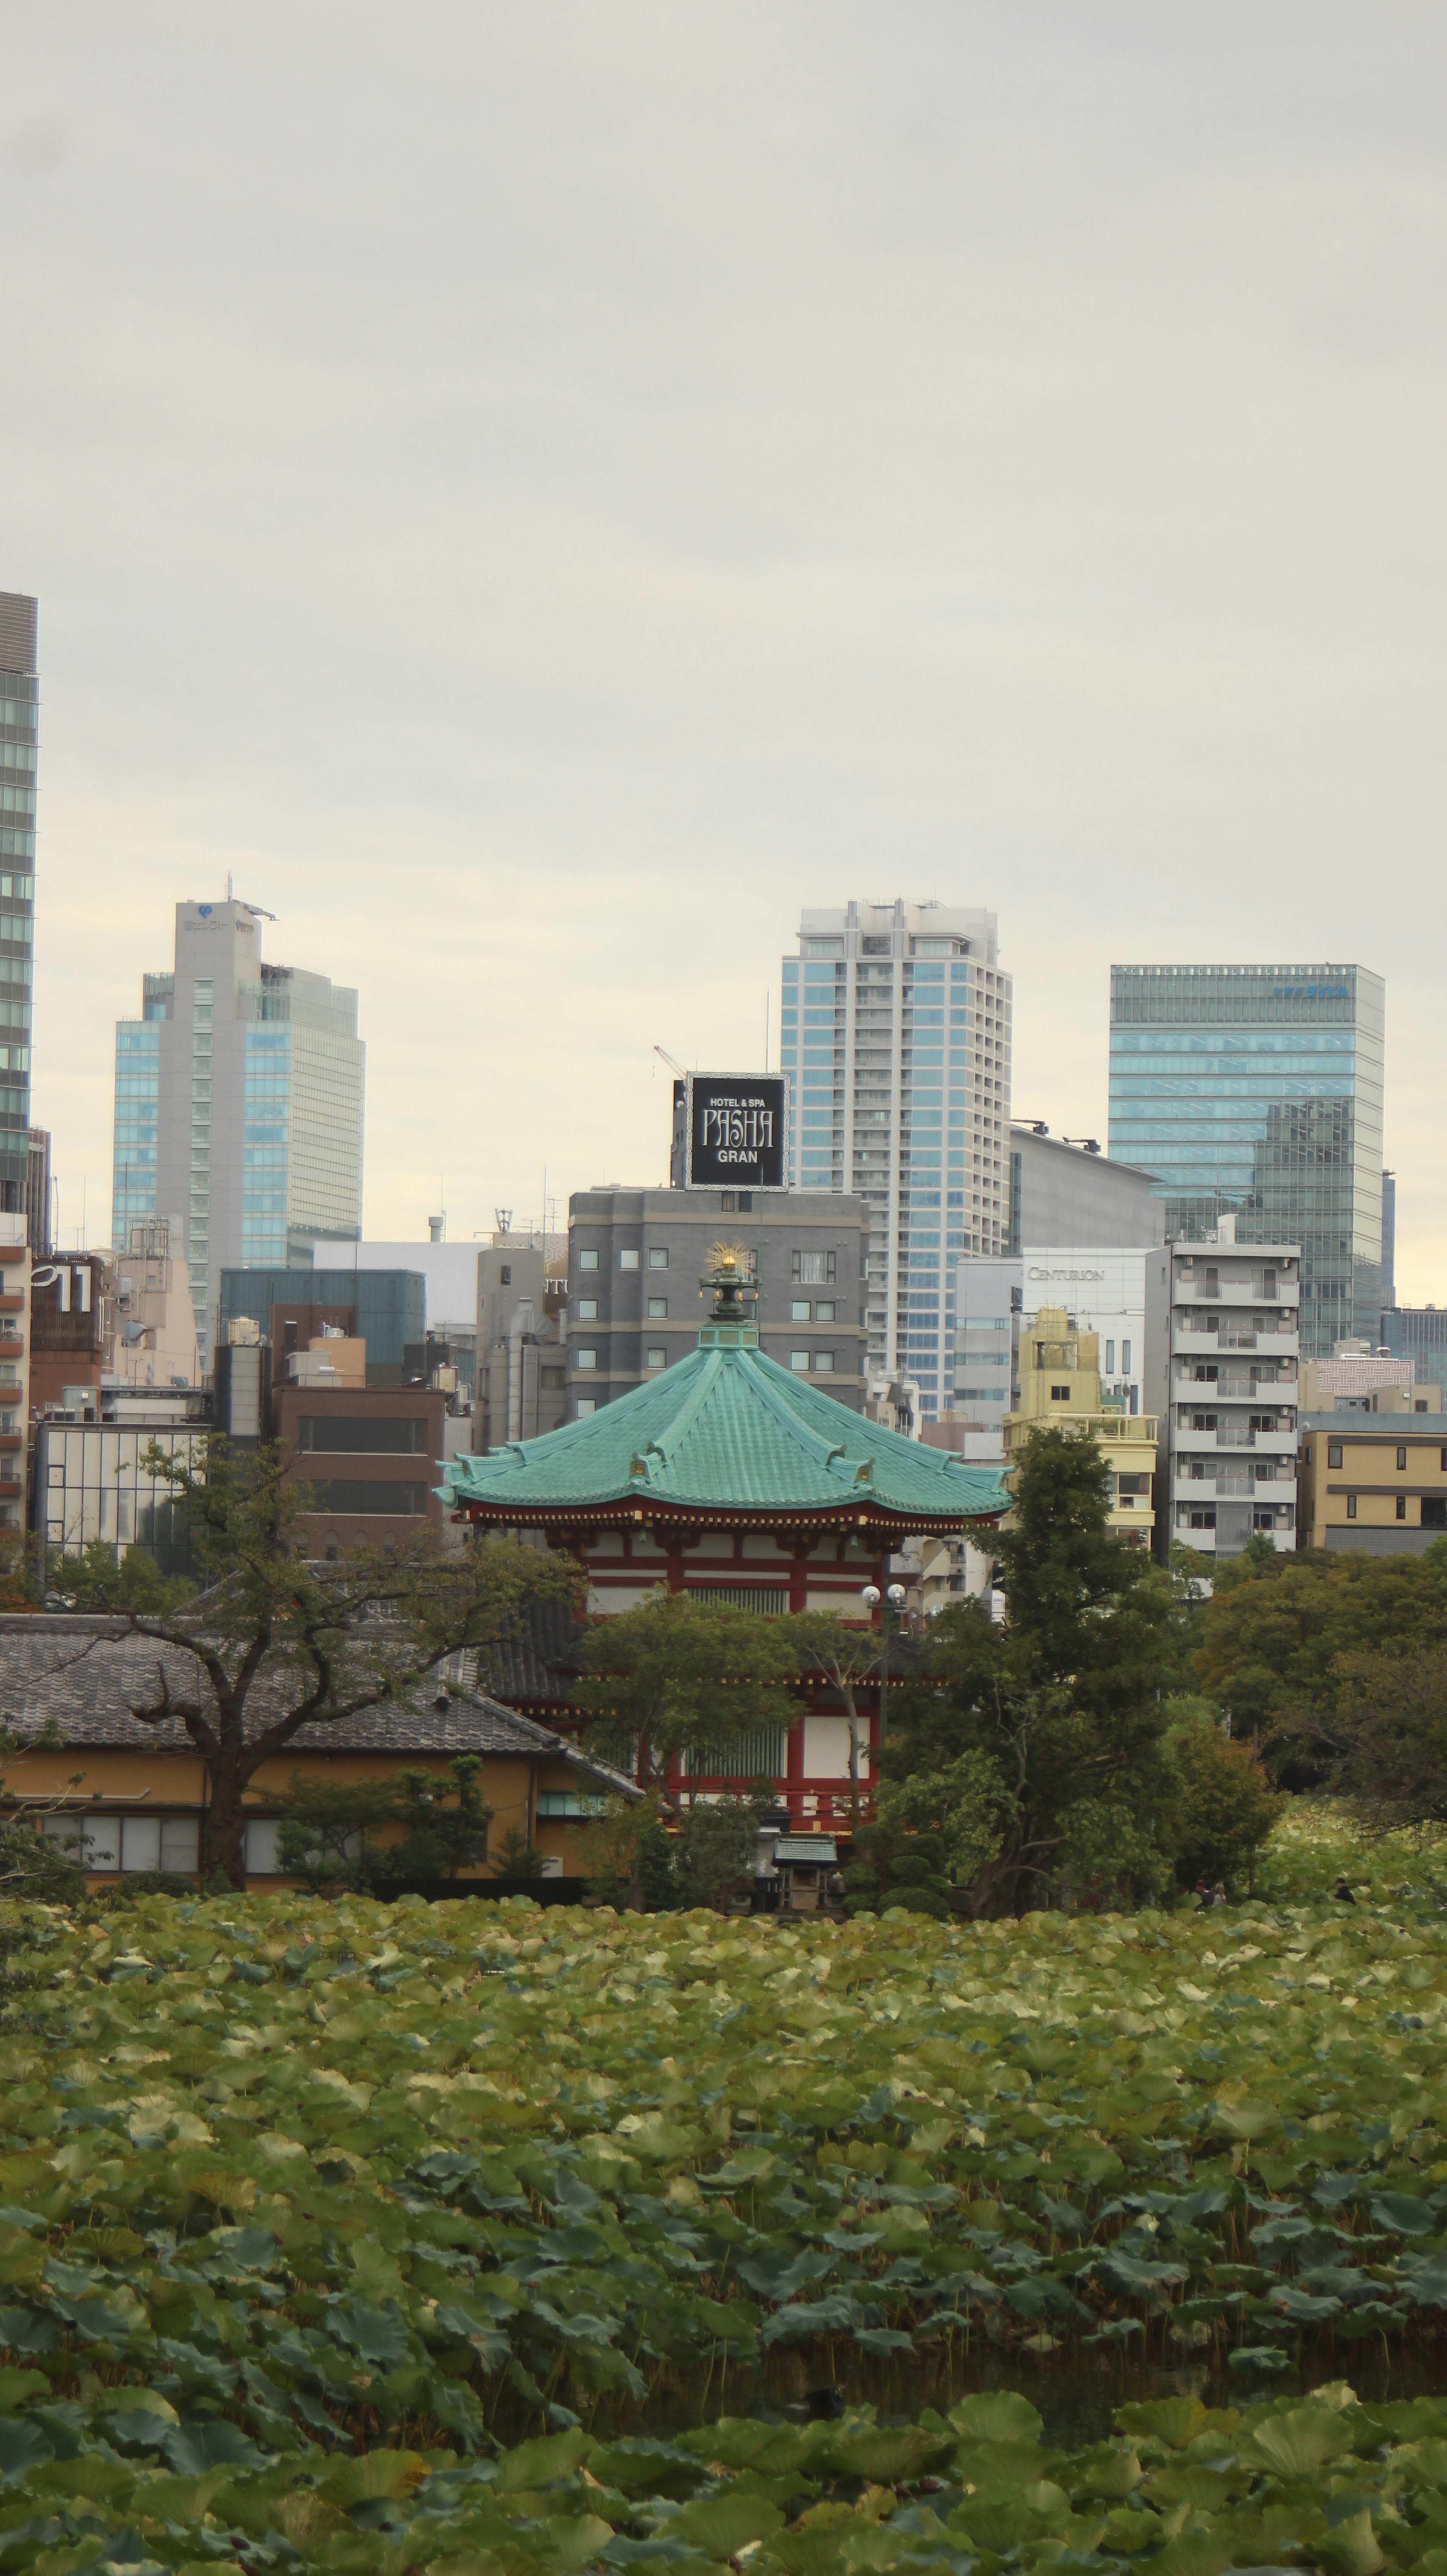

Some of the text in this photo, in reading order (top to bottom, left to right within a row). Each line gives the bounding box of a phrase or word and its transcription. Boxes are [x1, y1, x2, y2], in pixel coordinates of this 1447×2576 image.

[710, 1098, 766, 1107] HOTEL & SPA
[702, 1109, 774, 1148] PASHA
[718, 1150, 758, 1163] GRAN
[1028, 1266, 1105, 1280] CENTURION
